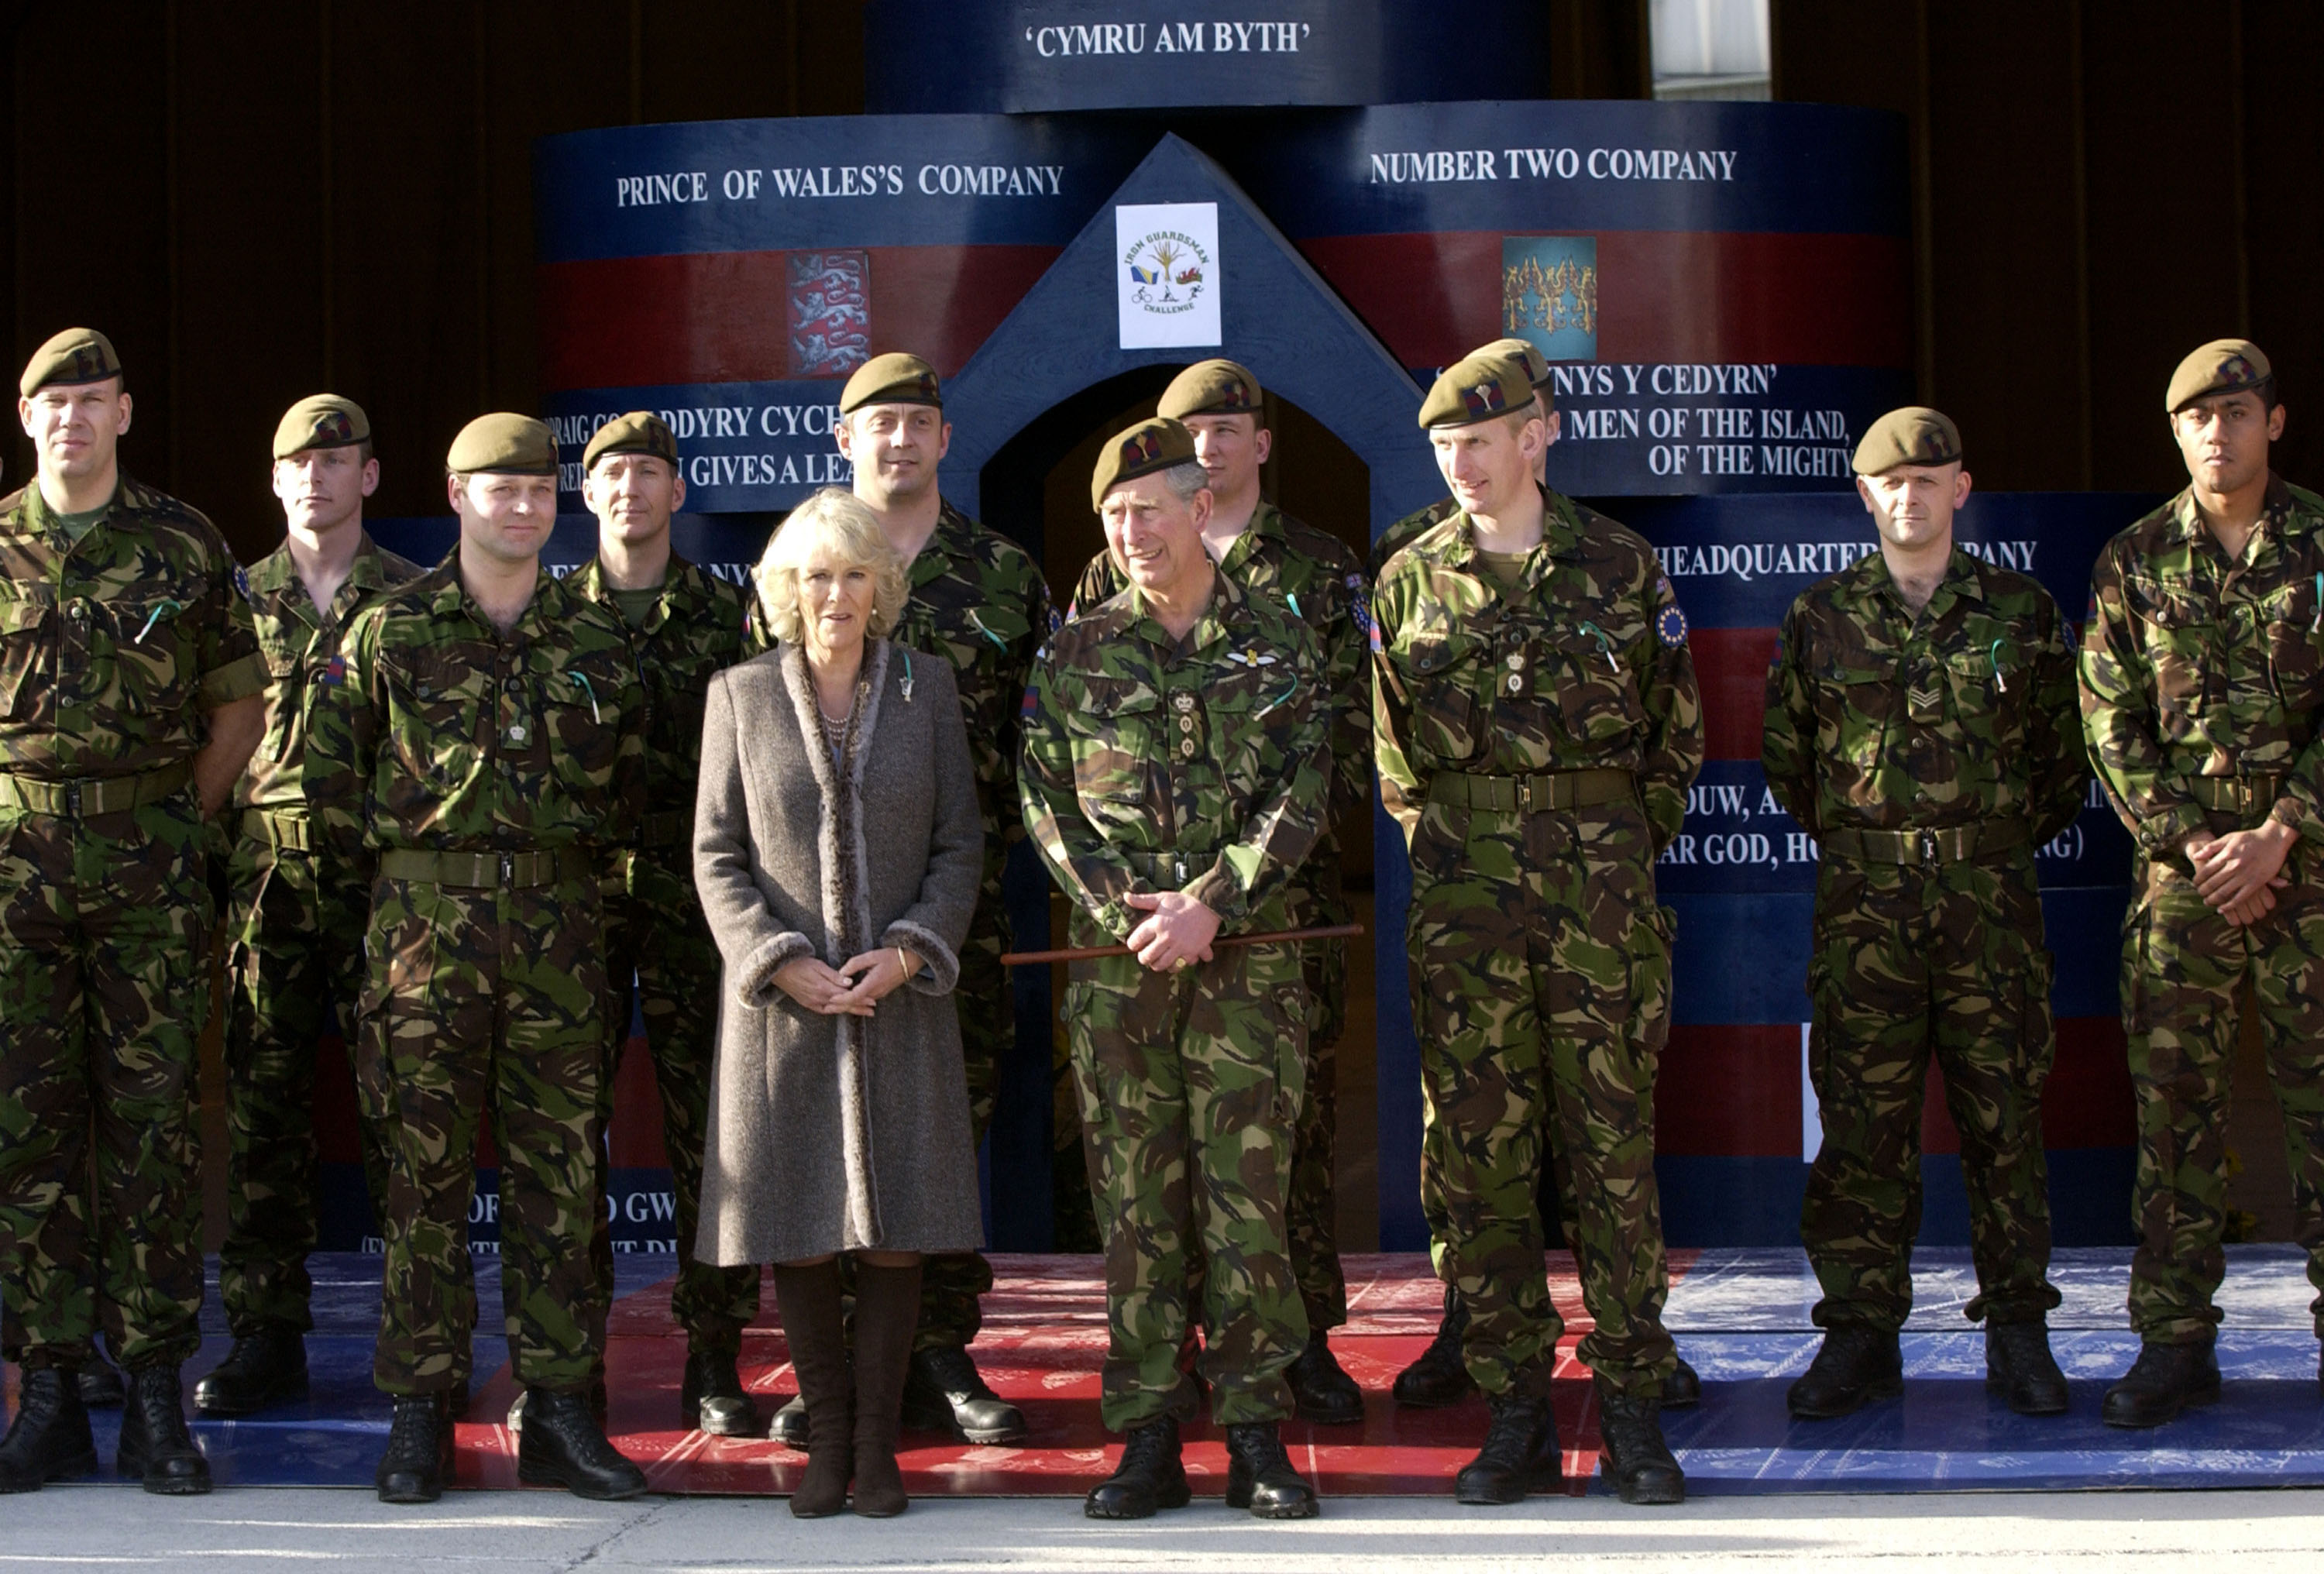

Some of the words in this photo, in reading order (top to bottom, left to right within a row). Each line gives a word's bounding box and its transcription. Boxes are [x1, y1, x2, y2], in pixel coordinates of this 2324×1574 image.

[1026, 23, 1147, 57] ‘CYMRU
[1154, 22, 1205, 53] AM
[1212, 22, 1311, 52] BYTH’
[1370, 150, 1497, 184] NUMBER
[1504, 148, 1580, 180] TWO
[1587, 148, 1737, 181] COMPANY
[617, 172, 708, 208] PRINCE
[723, 170, 762, 200] OF
[772, 165, 903, 198] WALES’S
[918, 164, 1064, 195] COMPANY
[1124, 239, 1145, 265] IRON
[1146, 231, 1210, 264] GUARDSMAN
[1143, 302, 1195, 314] CHALLENGE
[1548, 366, 1612, 397] NYS
[1621, 365, 1644, 395] Y
[1651, 364, 1777, 395] CEDYRN’
[1569, 408, 1640, 441] MEN
[1648, 407, 1690, 438] OF
[1697, 408, 1754, 438] THE
[1760, 408, 1850, 447] ISLAND,
[690, 454, 775, 486] GIVES
[779, 454, 800, 484] A
[1648, 445, 1690, 476] OF
[1697, 445, 1754, 475] THE
[1760, 445, 1855, 478] MIGHTY
[1703, 833, 1779, 871] GOD,
